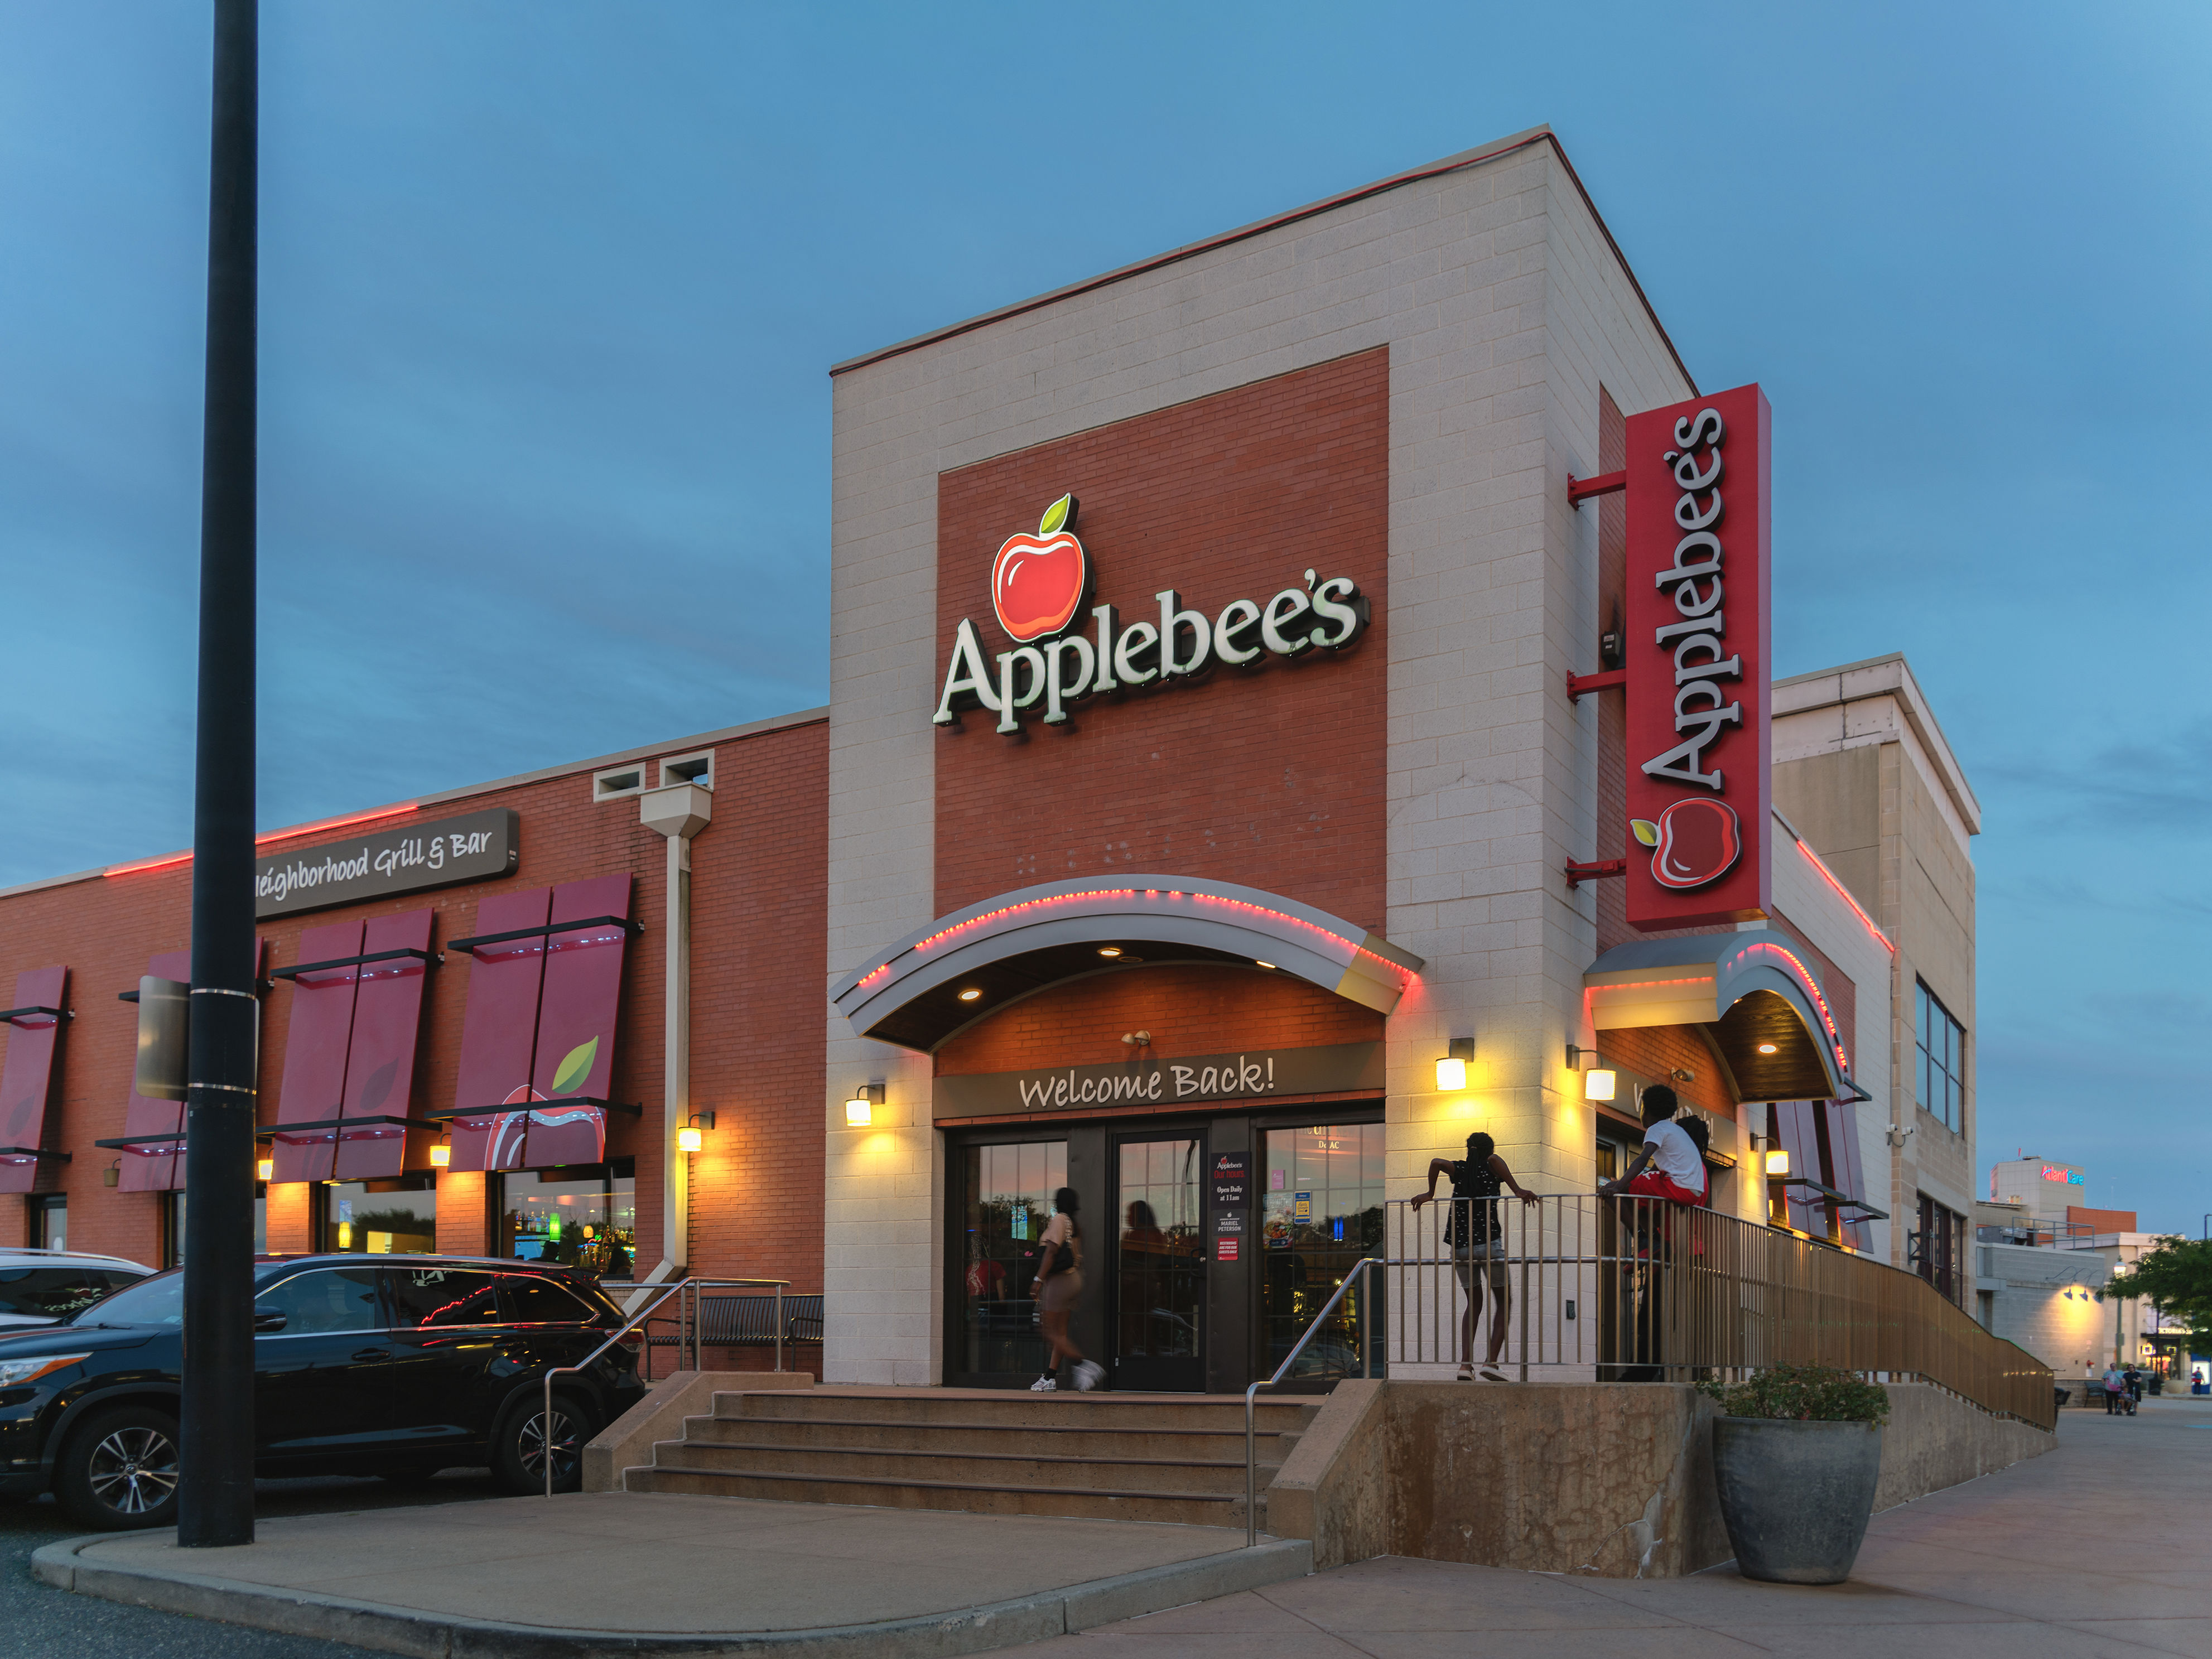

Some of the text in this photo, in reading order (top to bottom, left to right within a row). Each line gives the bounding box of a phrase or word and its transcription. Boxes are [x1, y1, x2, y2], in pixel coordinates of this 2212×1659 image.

[1641, 406, 1742, 792] Applebee's
[932, 568, 1359, 735] Applebee's
[374, 838, 425, 877] Grill
[427, 836, 445, 870] &
[449, 831, 492, 858] Bar
[1020, 1055, 1275, 1108] Welcome Back!
[1214, 1170, 1225, 1179] Our
